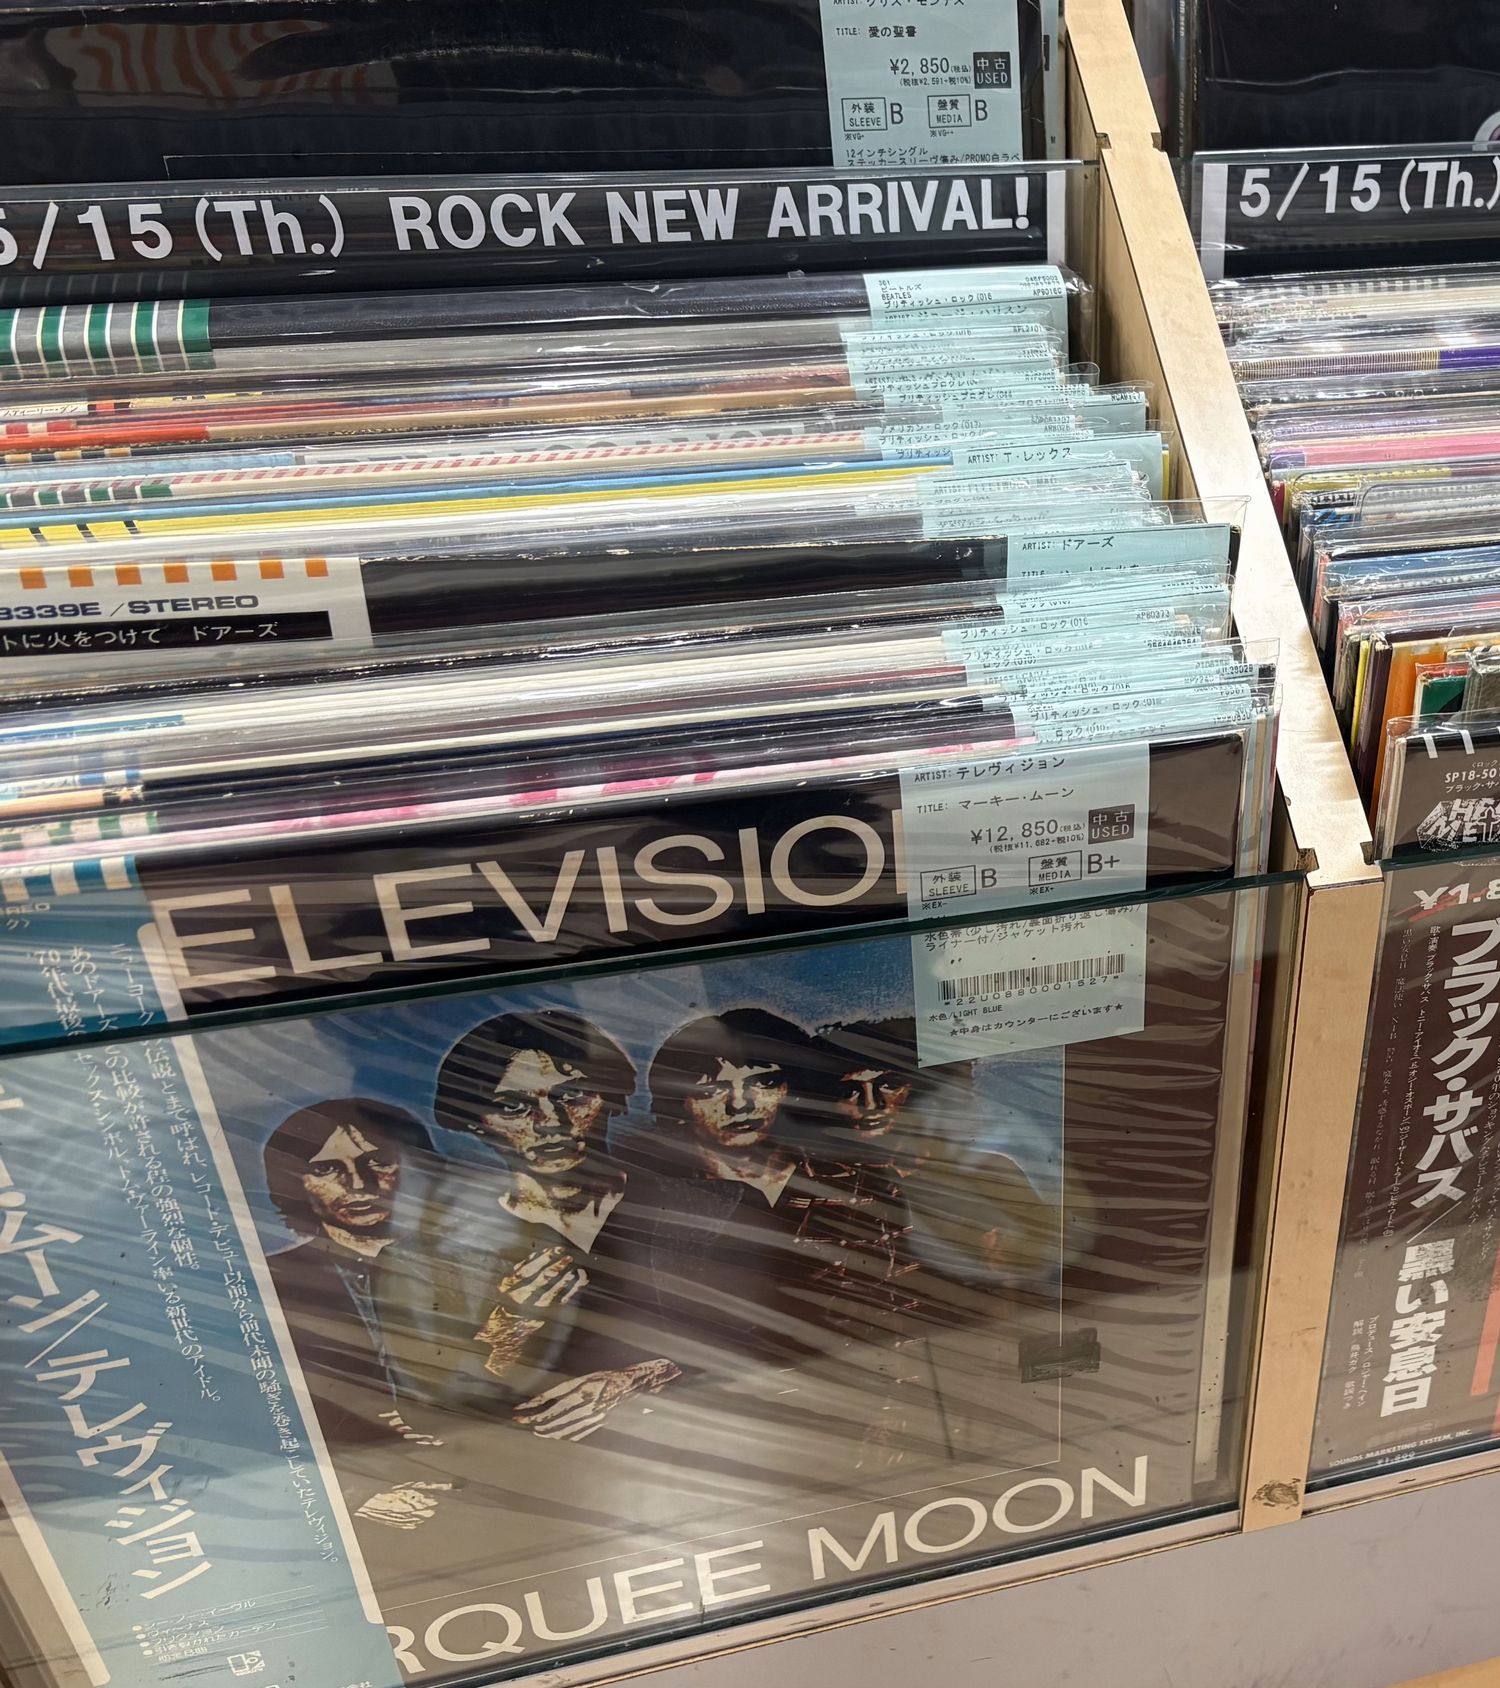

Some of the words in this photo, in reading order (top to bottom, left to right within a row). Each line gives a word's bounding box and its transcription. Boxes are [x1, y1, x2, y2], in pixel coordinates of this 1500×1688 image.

[836, 27, 860, 36] TITLE:
[868, 25, 917, 38] 愛の聖書
[890, 57, 949, 76] ¥2,850
[976, 57, 1007, 70] 中古
[976, 72, 1008, 84] USED
[851, 103, 875, 113] 外装
[937, 99, 960, 110] 盤質
[975, 100, 988, 121] B
[849, 117, 881, 127] SLEEVE
[890, 103, 903, 125] B
[936, 113, 962, 124] MEDIA
[846, 147, 928, 158] 12インチシングル
[1240, 162, 1383, 221] 5/15
[196, 195, 344, 261] (Th.)
[389, 192, 586, 251] ROCK
[605, 187, 740, 246] NEW
[767, 177, 1031, 239] ARRIVAL!
[881, 283, 922, 293] ビートルズ
[882, 292, 912, 301] BEATLES
[967, 454, 998, 464] ARTIST:
[1003, 447, 1072, 462] T・レックス
[1062, 535, 1114, 551] ドアーズ
[4, 628, 162, 651] トに火をつけて
[192, 622, 278, 642] ドアーズ
[914, 769, 951, 783] ARTIST:
[956, 756, 1066, 781] テレヴィジョン
[917, 802, 948, 814] TITLE:
[958, 787, 1075, 811] マーキー・ムーン
[1093, 810, 1130, 826] 中古
[971, 819, 1058, 846] ¥12,850
[1091, 824, 1130, 840] USED
[1040, 856, 1069, 868] 盤質
[1088, 853, 1120, 874] B+
[932, 871, 962, 885] 外装
[981, 868, 998, 889] B
[1038, 870, 1072, 882] MEDIA
[928, 883, 970, 898] SLEEVE
[150, 814, 908, 990] ELEVISIO
[925, 921, 1085, 952] ライナー付/ジャケット汚れ
[111, 943, 154, 1026] ニューヨーク
[983, 1004, 1003, 1014] BLUE
[1328, 1455, 1364, 1467] SOUNDS
[1365, 1441, 1418, 1459] MARKETING
[1418, 1433, 1454, 1447] SYSTEM,
[809, 1455, 1148, 1581] MOON
